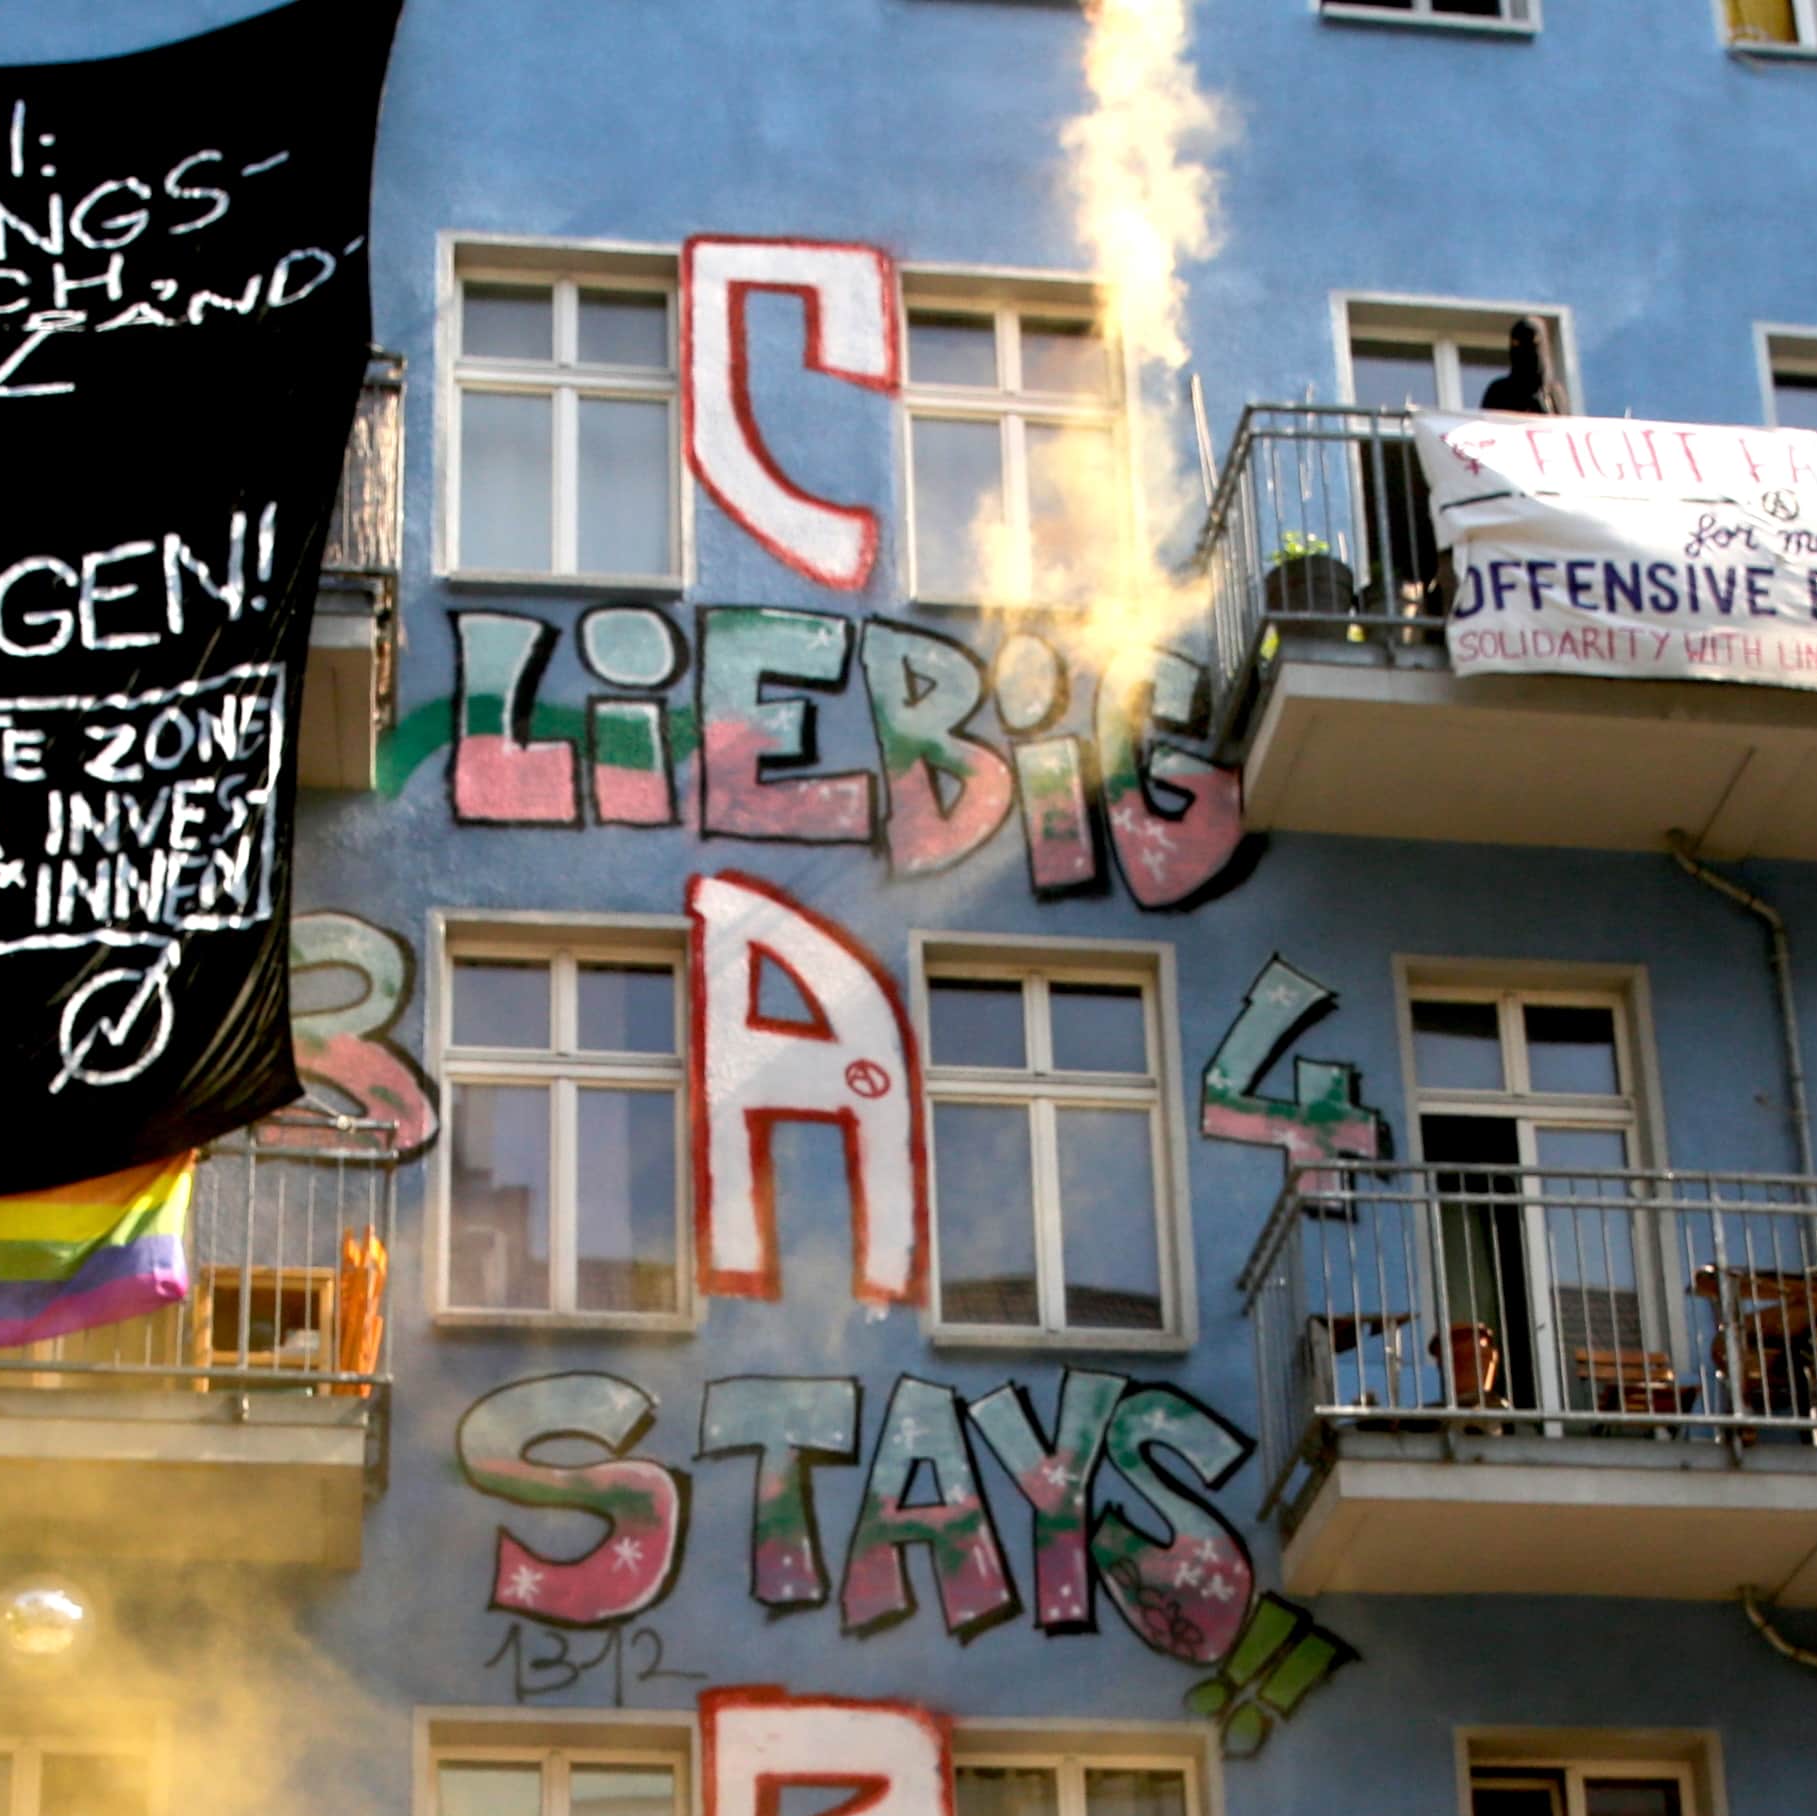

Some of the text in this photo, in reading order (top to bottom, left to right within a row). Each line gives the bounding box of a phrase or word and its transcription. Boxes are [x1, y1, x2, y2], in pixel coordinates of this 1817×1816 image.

[1528, 429, 1703, 487] FIGHT
[1684, 514, 1759, 560] for
[1453, 558, 1778, 620] OFFENSIVE
[1456, 622, 1674, 665] SOLIDARITY
[1686, 632, 1763, 667] WITH
[83, 693, 271, 782] ZONE
